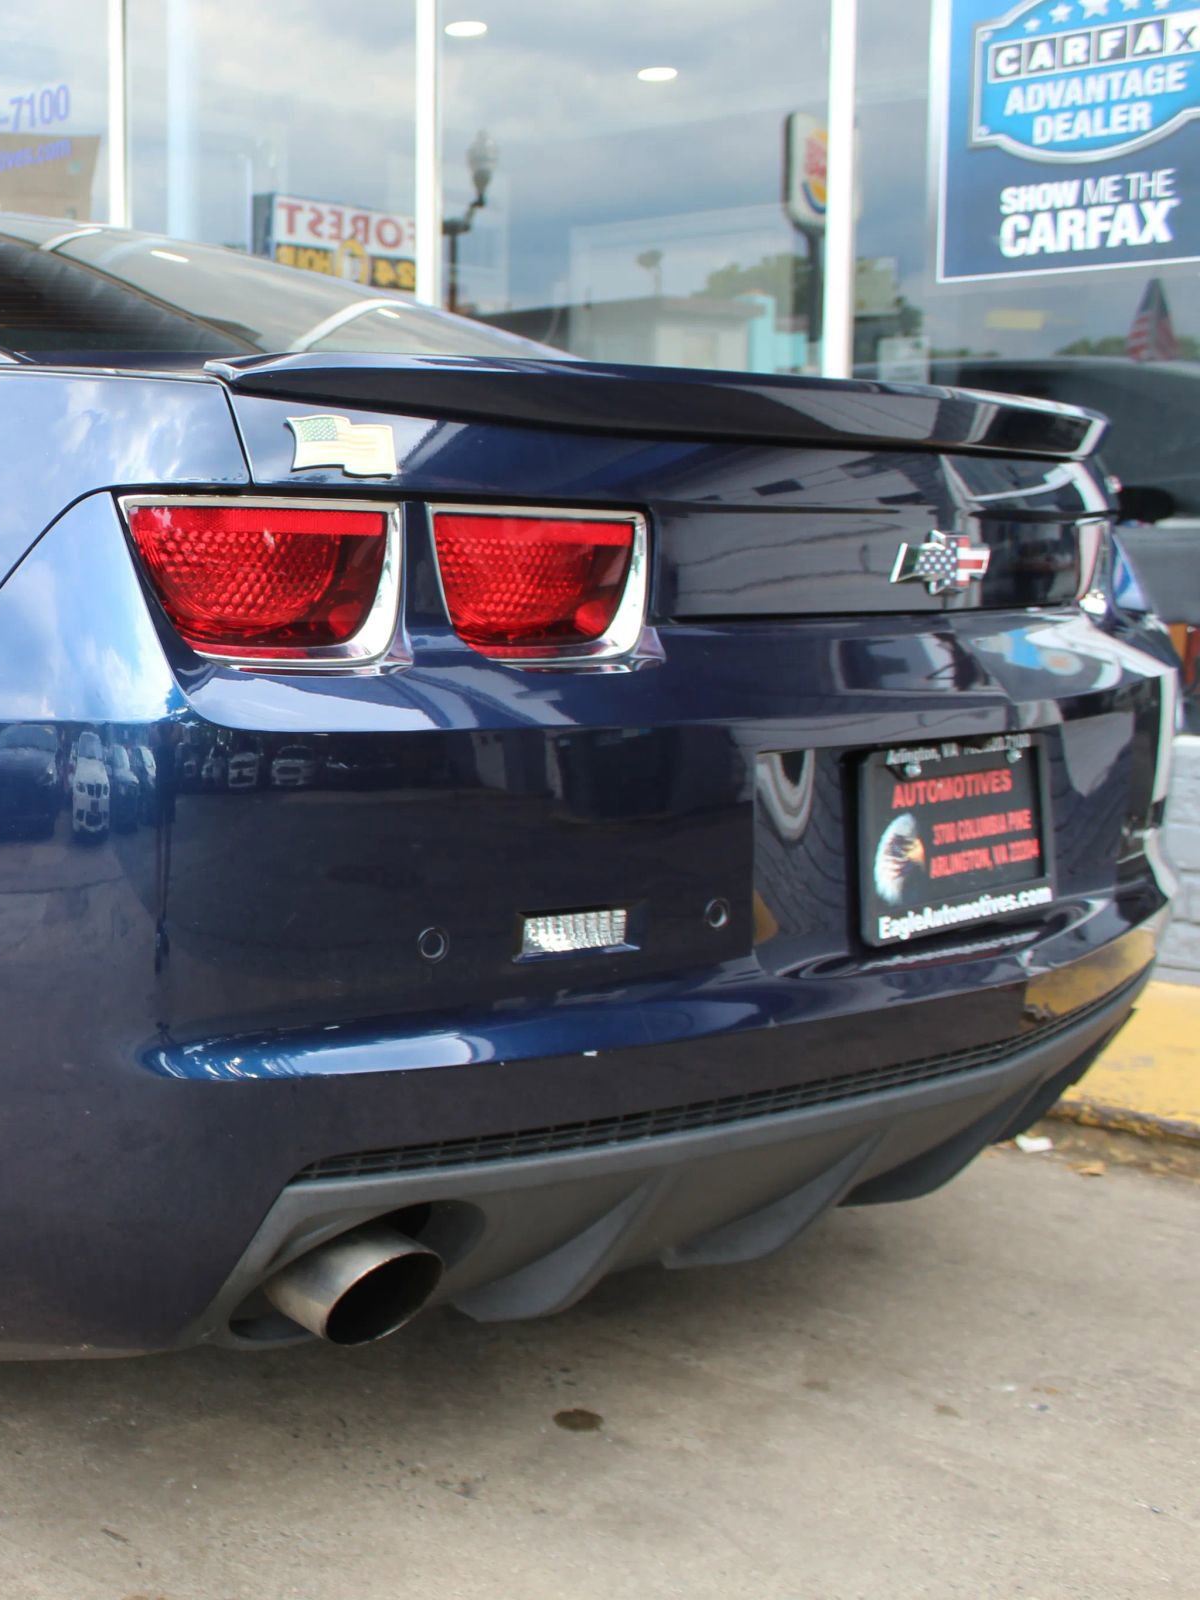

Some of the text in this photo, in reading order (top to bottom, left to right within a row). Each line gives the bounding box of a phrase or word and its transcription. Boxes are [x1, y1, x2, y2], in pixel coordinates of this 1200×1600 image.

[995, 18, 1200, 76] CARFAX
[1003, 61, 1191, 117] ADVANTAGE
[1032, 101, 1153, 145] DEALER
[1000, 168, 1176, 214] SHOW ME THE
[1000, 198, 1181, 258] CARFAX
[891, 768, 1013, 809] AUTOMOTIVES
[957, 813, 1008, 841] COLUMBIA
[1007, 808, 1032, 831] PIKE
[930, 847, 993, 879] ARLINGTON,
[992, 844, 1009, 865] VA
[878, 887, 1053, 940] EagleAutomotives.com
